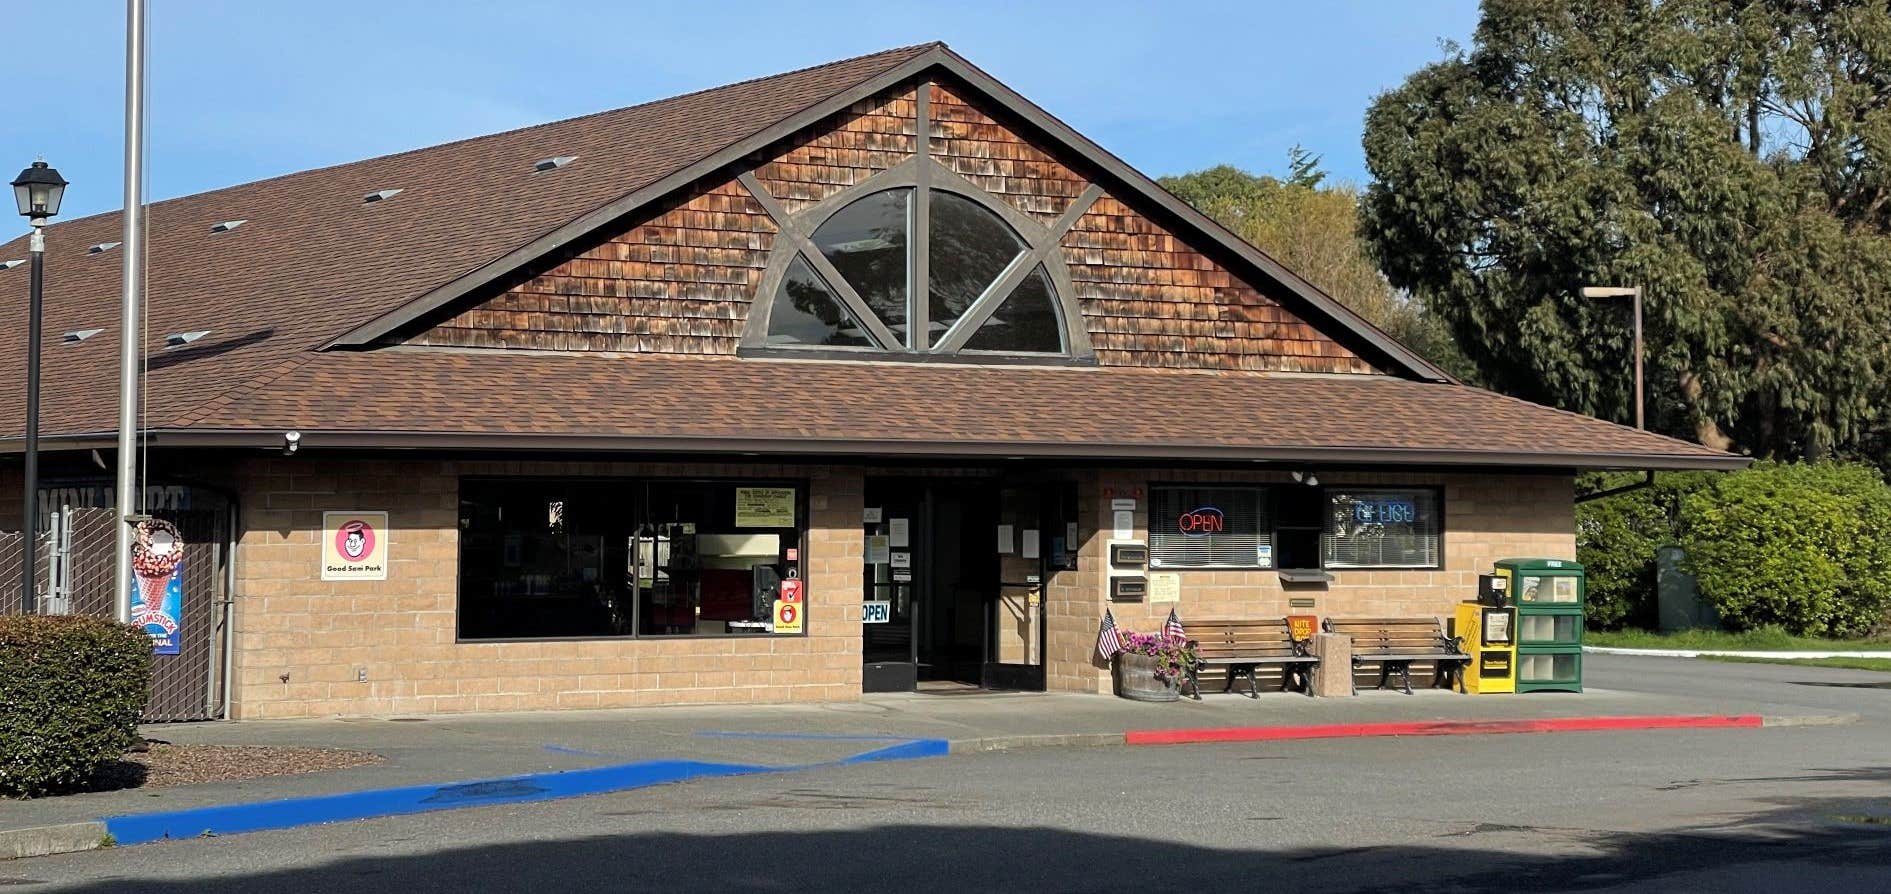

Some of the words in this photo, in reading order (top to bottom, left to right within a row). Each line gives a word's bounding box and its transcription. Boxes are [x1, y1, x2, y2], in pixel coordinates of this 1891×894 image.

[1179, 513, 1223, 531] OPEN
[862, 604, 888, 621] OPEN
[132, 613, 176, 633] RUMSTICK
[1294, 619, 1312, 628] NITE
